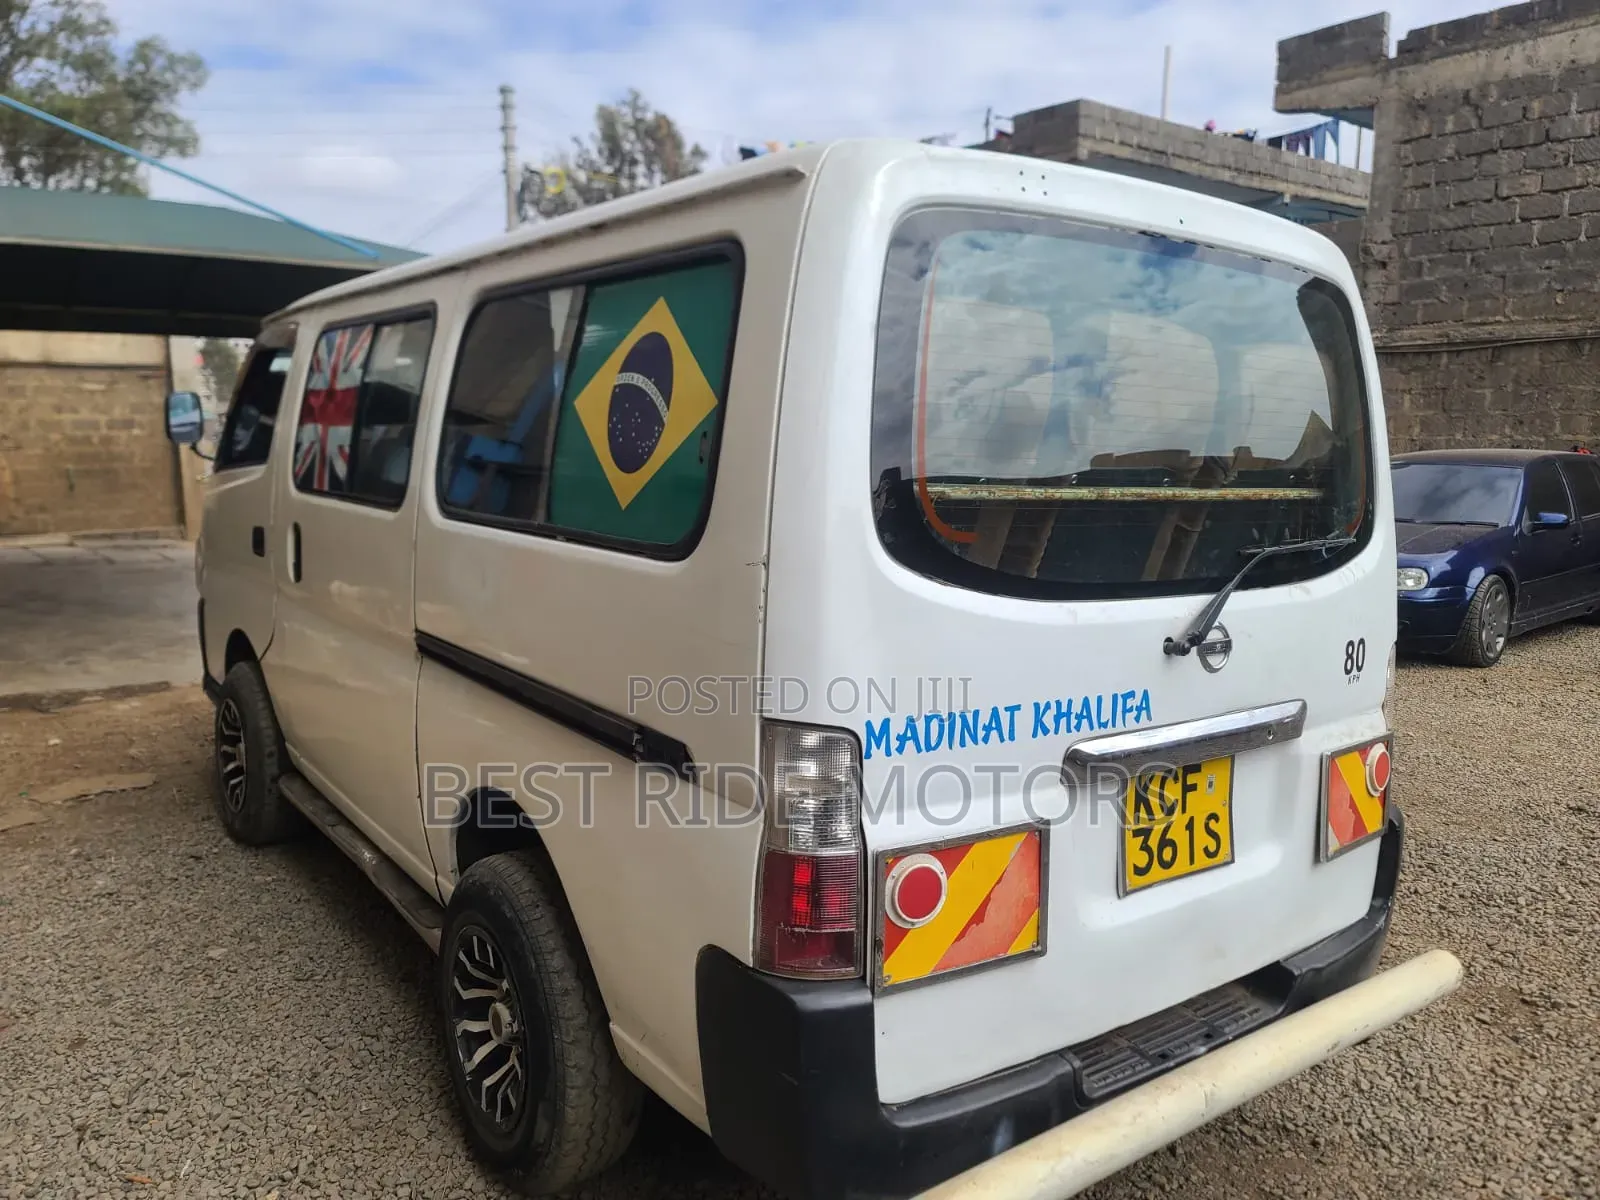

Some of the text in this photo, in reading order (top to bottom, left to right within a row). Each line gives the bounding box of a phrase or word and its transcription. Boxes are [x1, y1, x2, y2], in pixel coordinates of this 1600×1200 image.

[1343, 637, 1366, 675] 80
[1347, 674, 1361, 686] KPH
[864, 688, 1153, 760] MADINAT KHALIFA
[1133, 764, 1203, 824] KCF
[1132, 812, 1222, 877] 361S
